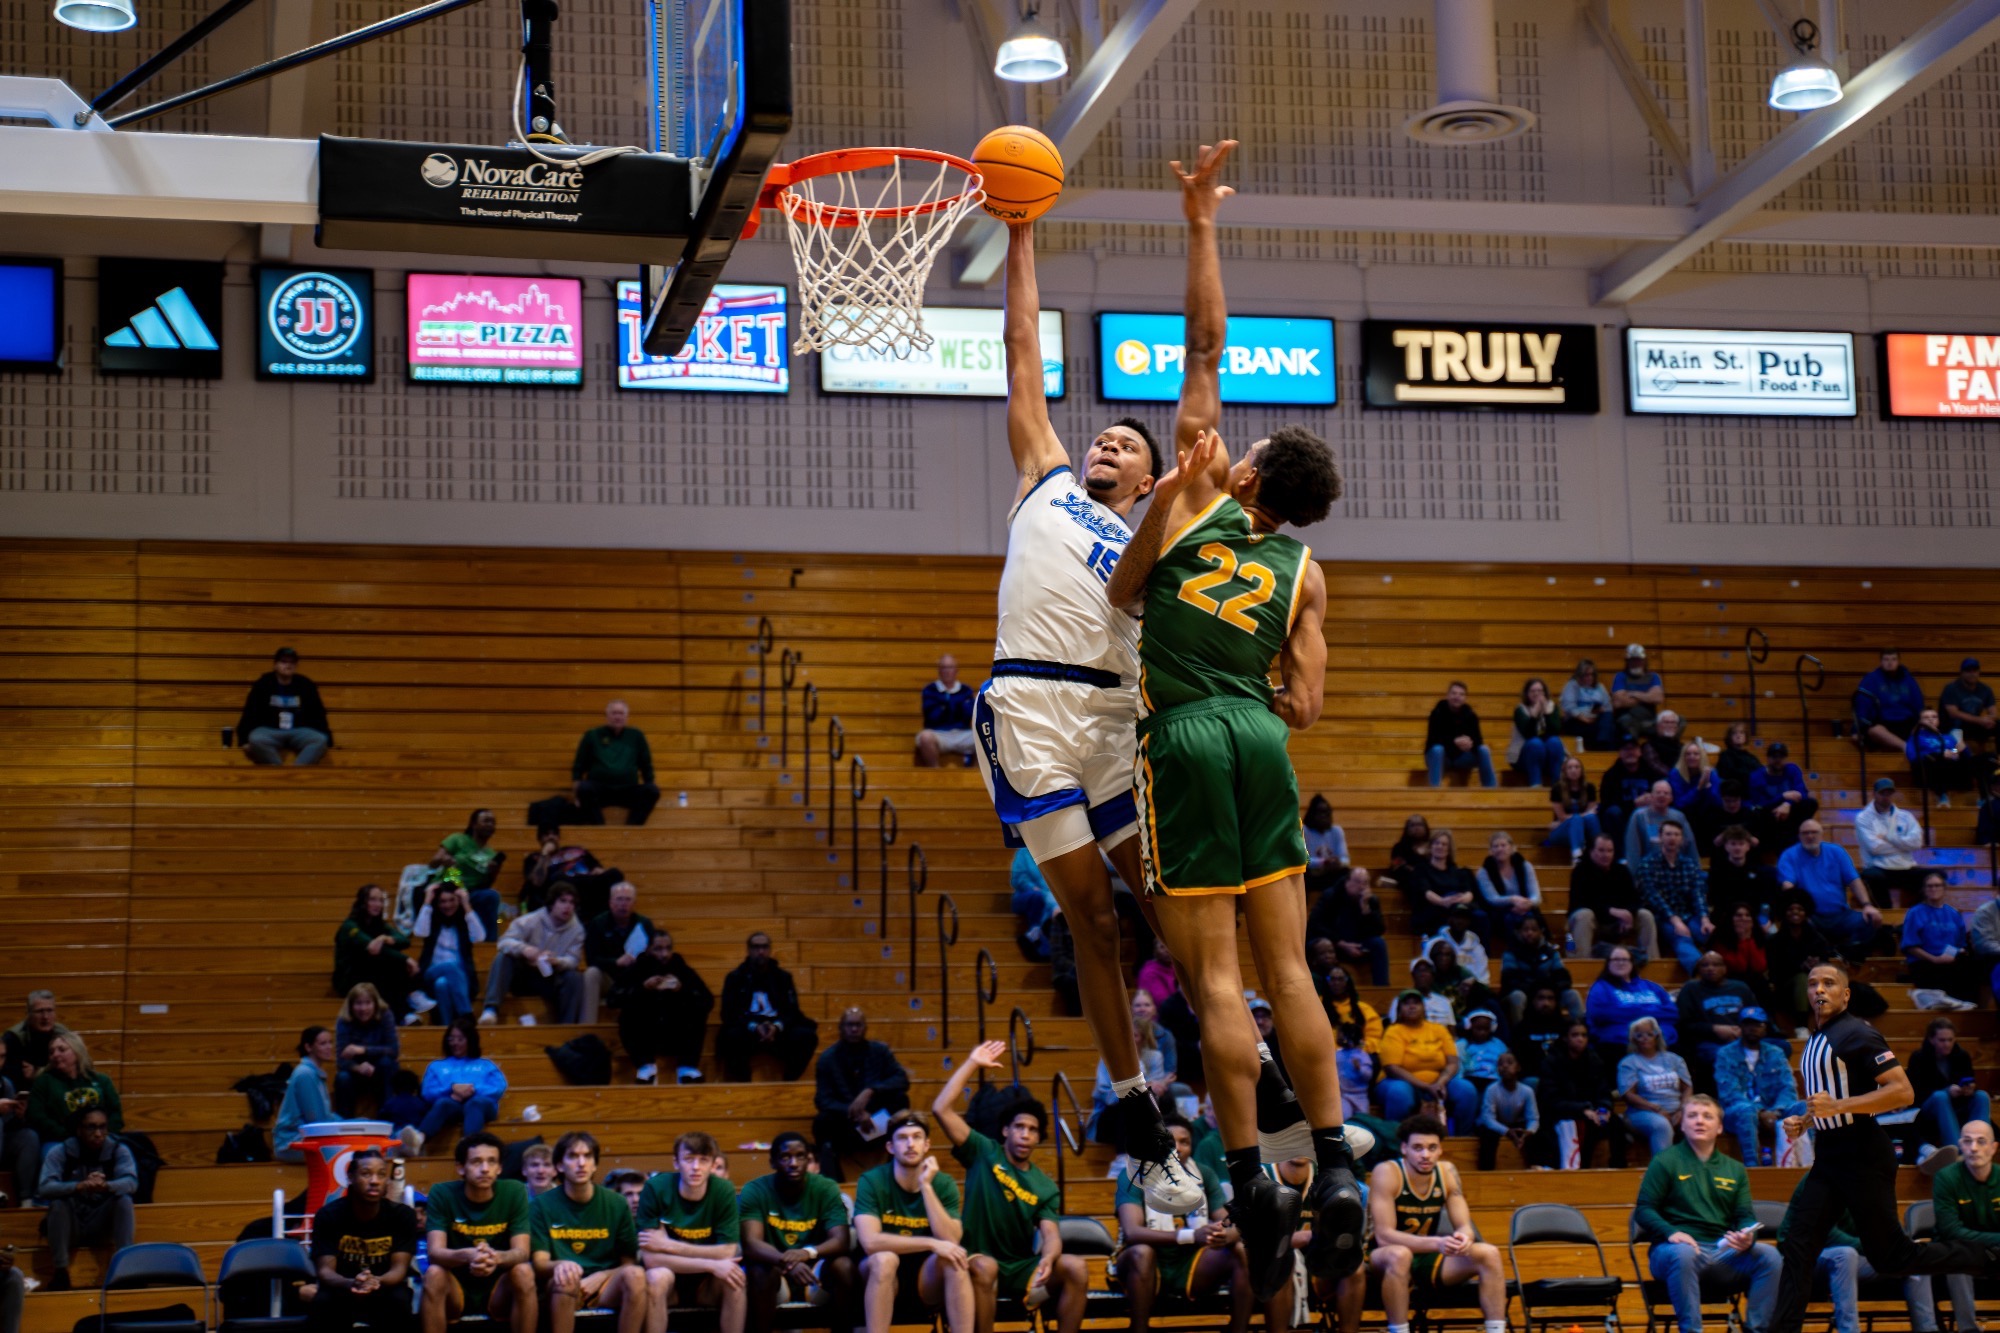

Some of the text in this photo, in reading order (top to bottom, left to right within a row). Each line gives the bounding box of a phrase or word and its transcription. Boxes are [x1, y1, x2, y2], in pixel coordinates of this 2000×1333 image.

[460, 159, 584, 188] NovaCare
[461, 188, 579, 203] REHABILITATION
[460, 207, 477, 216] The
[477, 208, 502, 217] Power
[503, 209, 512, 217] of
[512, 210, 545, 220] Physical
[294, 298, 338, 336] JJ
[479, 324, 573, 347] PIZZA
[618, 309, 786, 367] TKET
[1393, 330, 1562, 383] TRULY
[1646, 350, 1823, 377] Main St. Pub
[1760, 379, 1841, 392] Food Fun
[1947, 369, 2000, 401] FA
[1177, 542, 1276, 635] 22
[549, 1228, 609, 1239] WARRIORS
